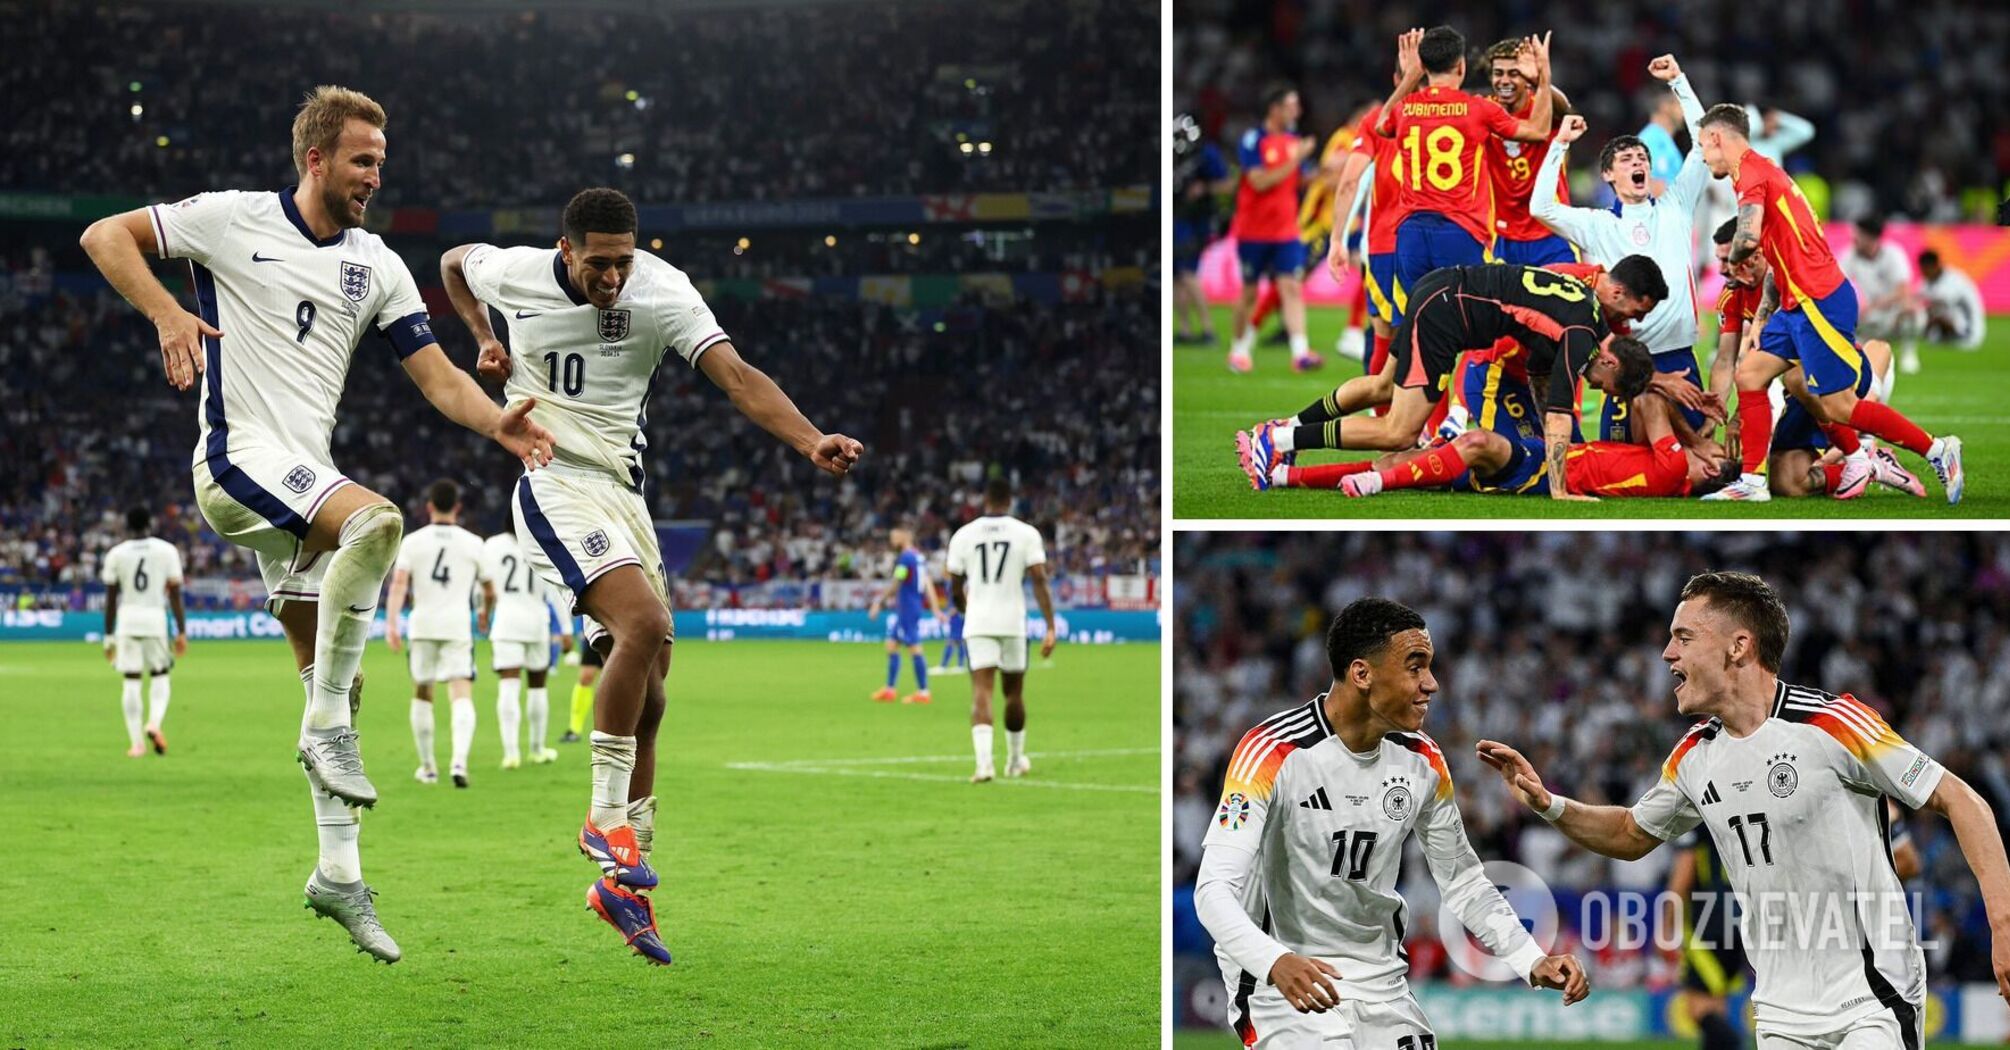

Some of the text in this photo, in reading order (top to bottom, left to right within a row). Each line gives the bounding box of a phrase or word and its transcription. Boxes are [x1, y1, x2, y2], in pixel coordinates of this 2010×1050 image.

[1402, 102, 1468, 116] ZUBIMENDI
[1403, 125, 1465, 191] 18
[1506, 157, 1531, 180] 19
[296, 300, 317, 345] 9
[544, 351, 586, 398] 10
[1502, 393, 1525, 419] 6
[134, 558, 148, 592] 6
[431, 548, 451, 588] 4
[975, 540, 1011, 585] 17
[1330, 829, 1378, 882] 10
[1727, 812, 1775, 868] 17
